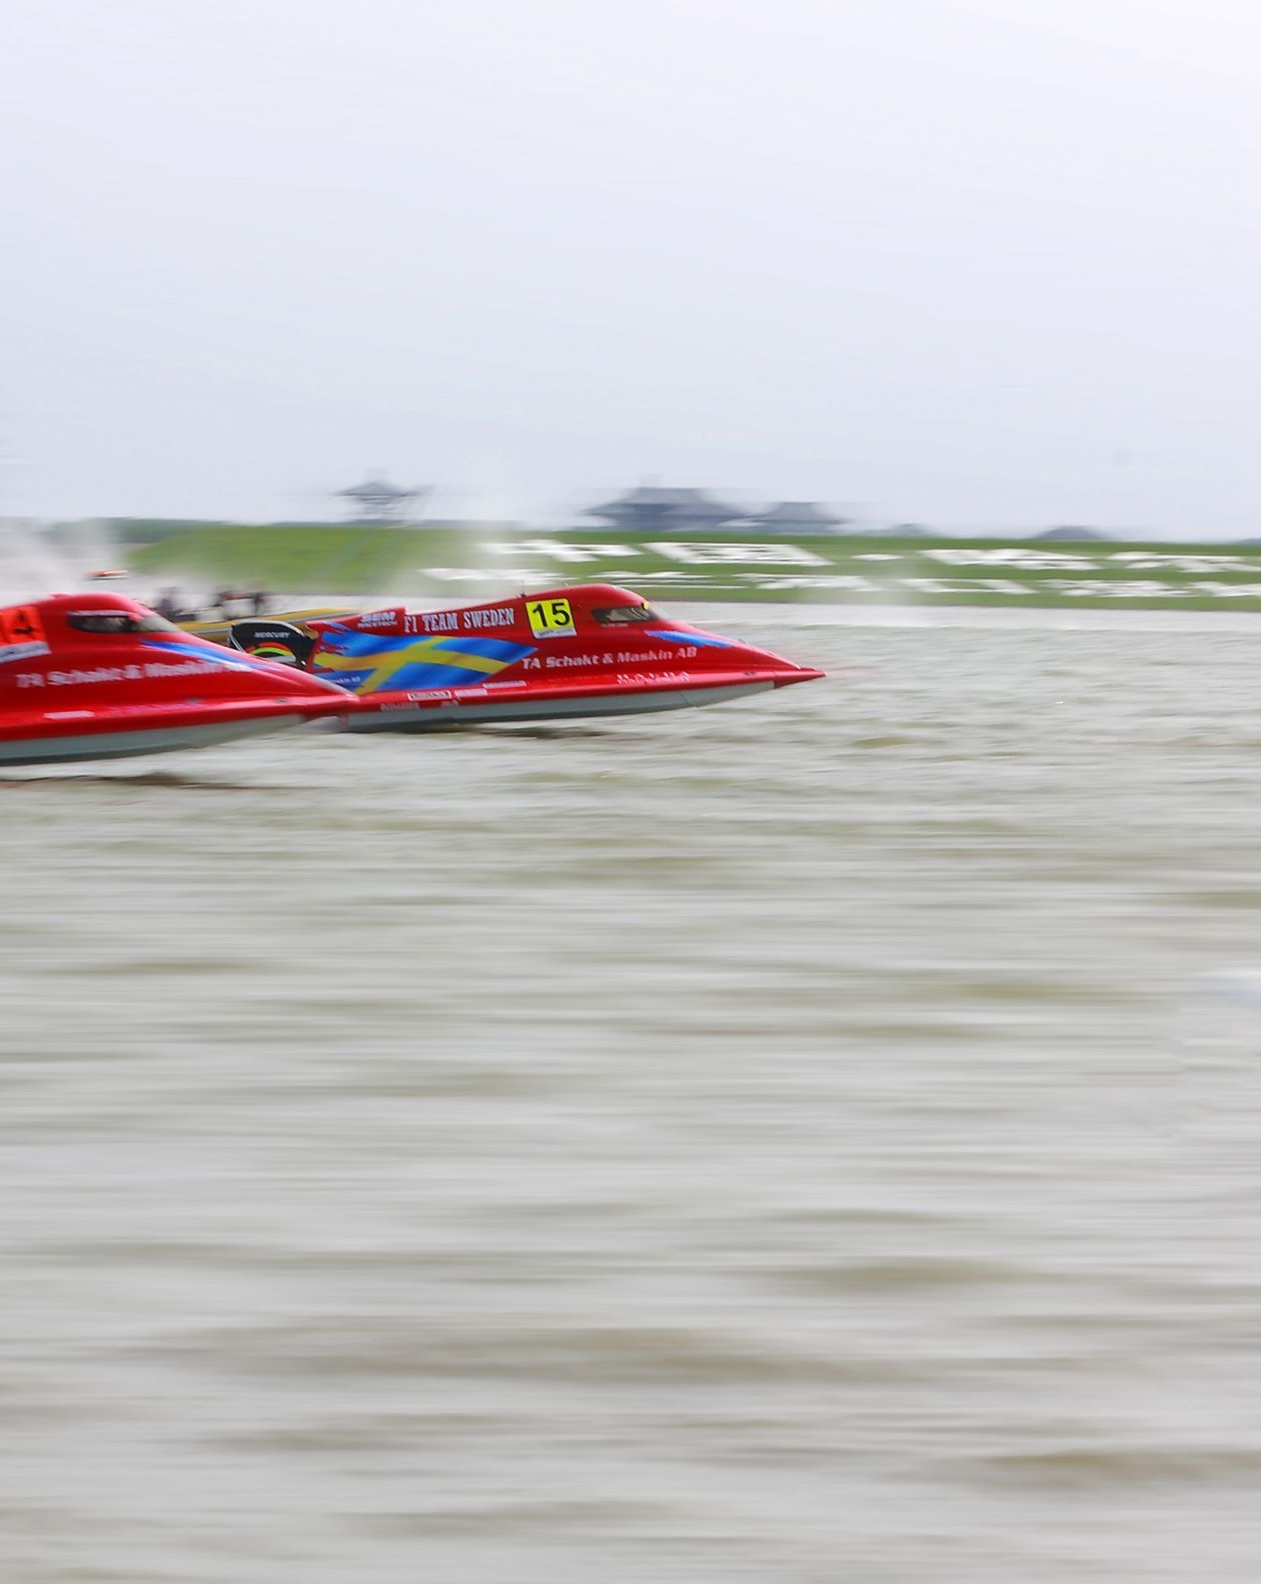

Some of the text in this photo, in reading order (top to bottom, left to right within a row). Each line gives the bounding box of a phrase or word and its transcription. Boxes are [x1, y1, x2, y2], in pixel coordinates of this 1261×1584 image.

[404, 607, 515, 633] F1 TEAM SWEDEN
[532, 601, 570, 628] 15
[521, 646, 698, 670] TA Schakt & Maskin AB
